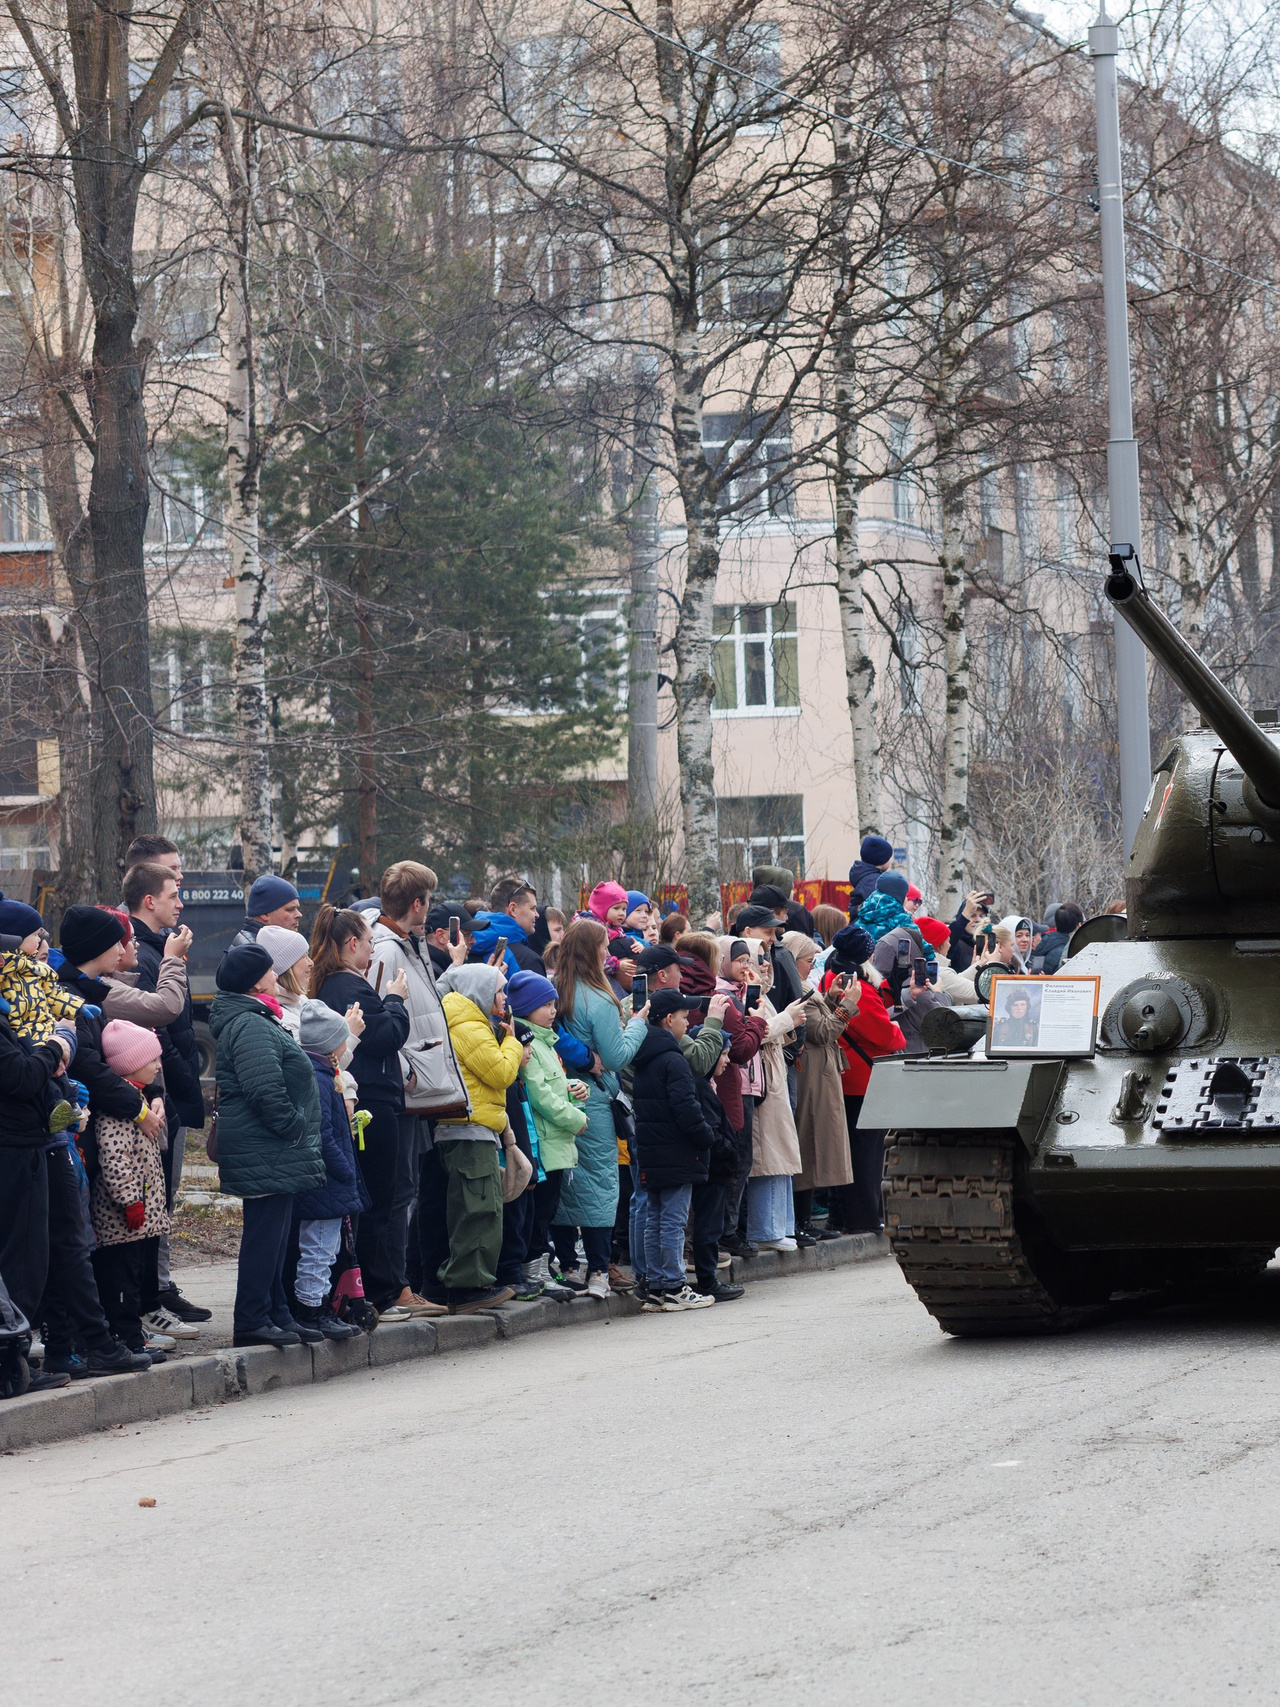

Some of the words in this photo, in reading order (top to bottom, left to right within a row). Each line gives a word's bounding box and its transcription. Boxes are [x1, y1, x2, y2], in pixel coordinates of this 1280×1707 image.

[182, 890, 190, 900] 8
[191, 890, 211, 900] 800
[212, 890, 230, 900] 222
[231, 890, 245, 900] 40
